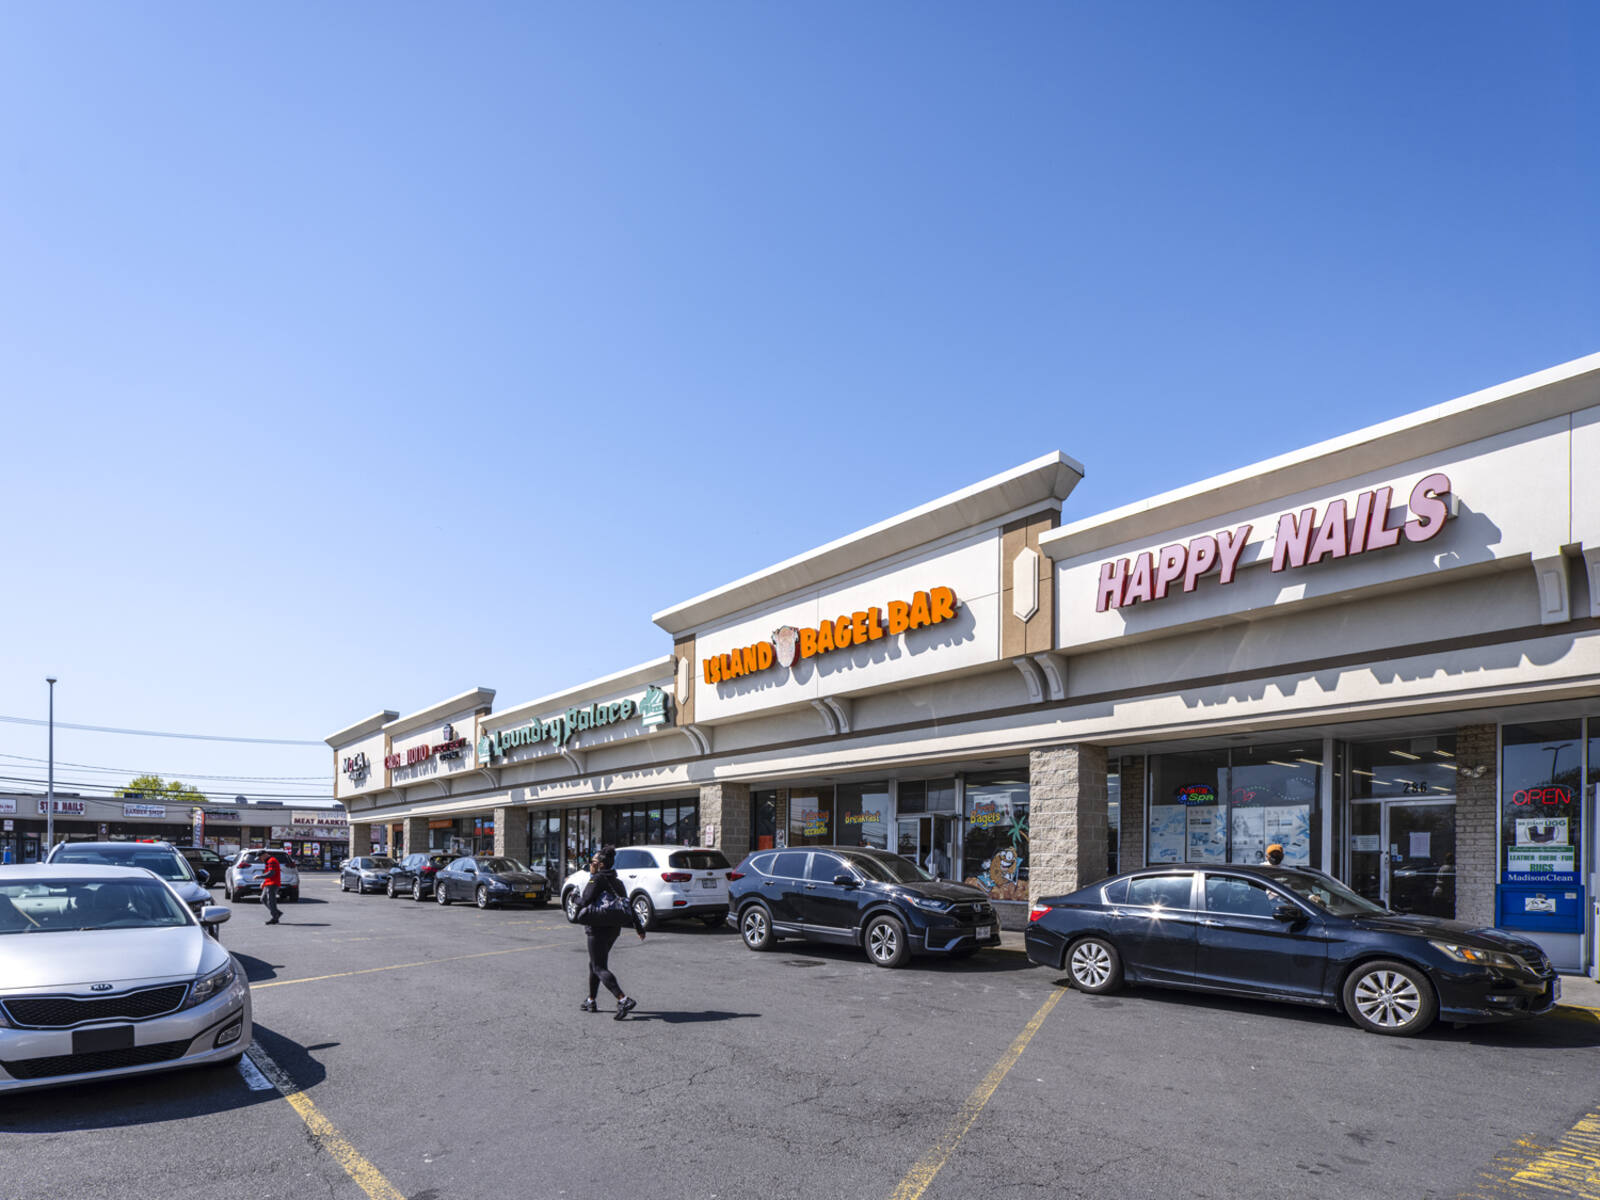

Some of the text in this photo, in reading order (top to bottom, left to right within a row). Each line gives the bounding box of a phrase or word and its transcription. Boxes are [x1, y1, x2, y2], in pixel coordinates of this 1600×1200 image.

[1096, 473, 1452, 613] HAPPY NAILS
[703, 586, 958, 684] ISLAND BAGEL BAR
[494, 717, 564, 757] Laundry
[563, 699, 635, 746] Palace
[40, 801, 84, 811] STR NAILS
[1513, 788, 1571, 806] OPEN
[1508, 873, 1573, 881] MadisonClean
